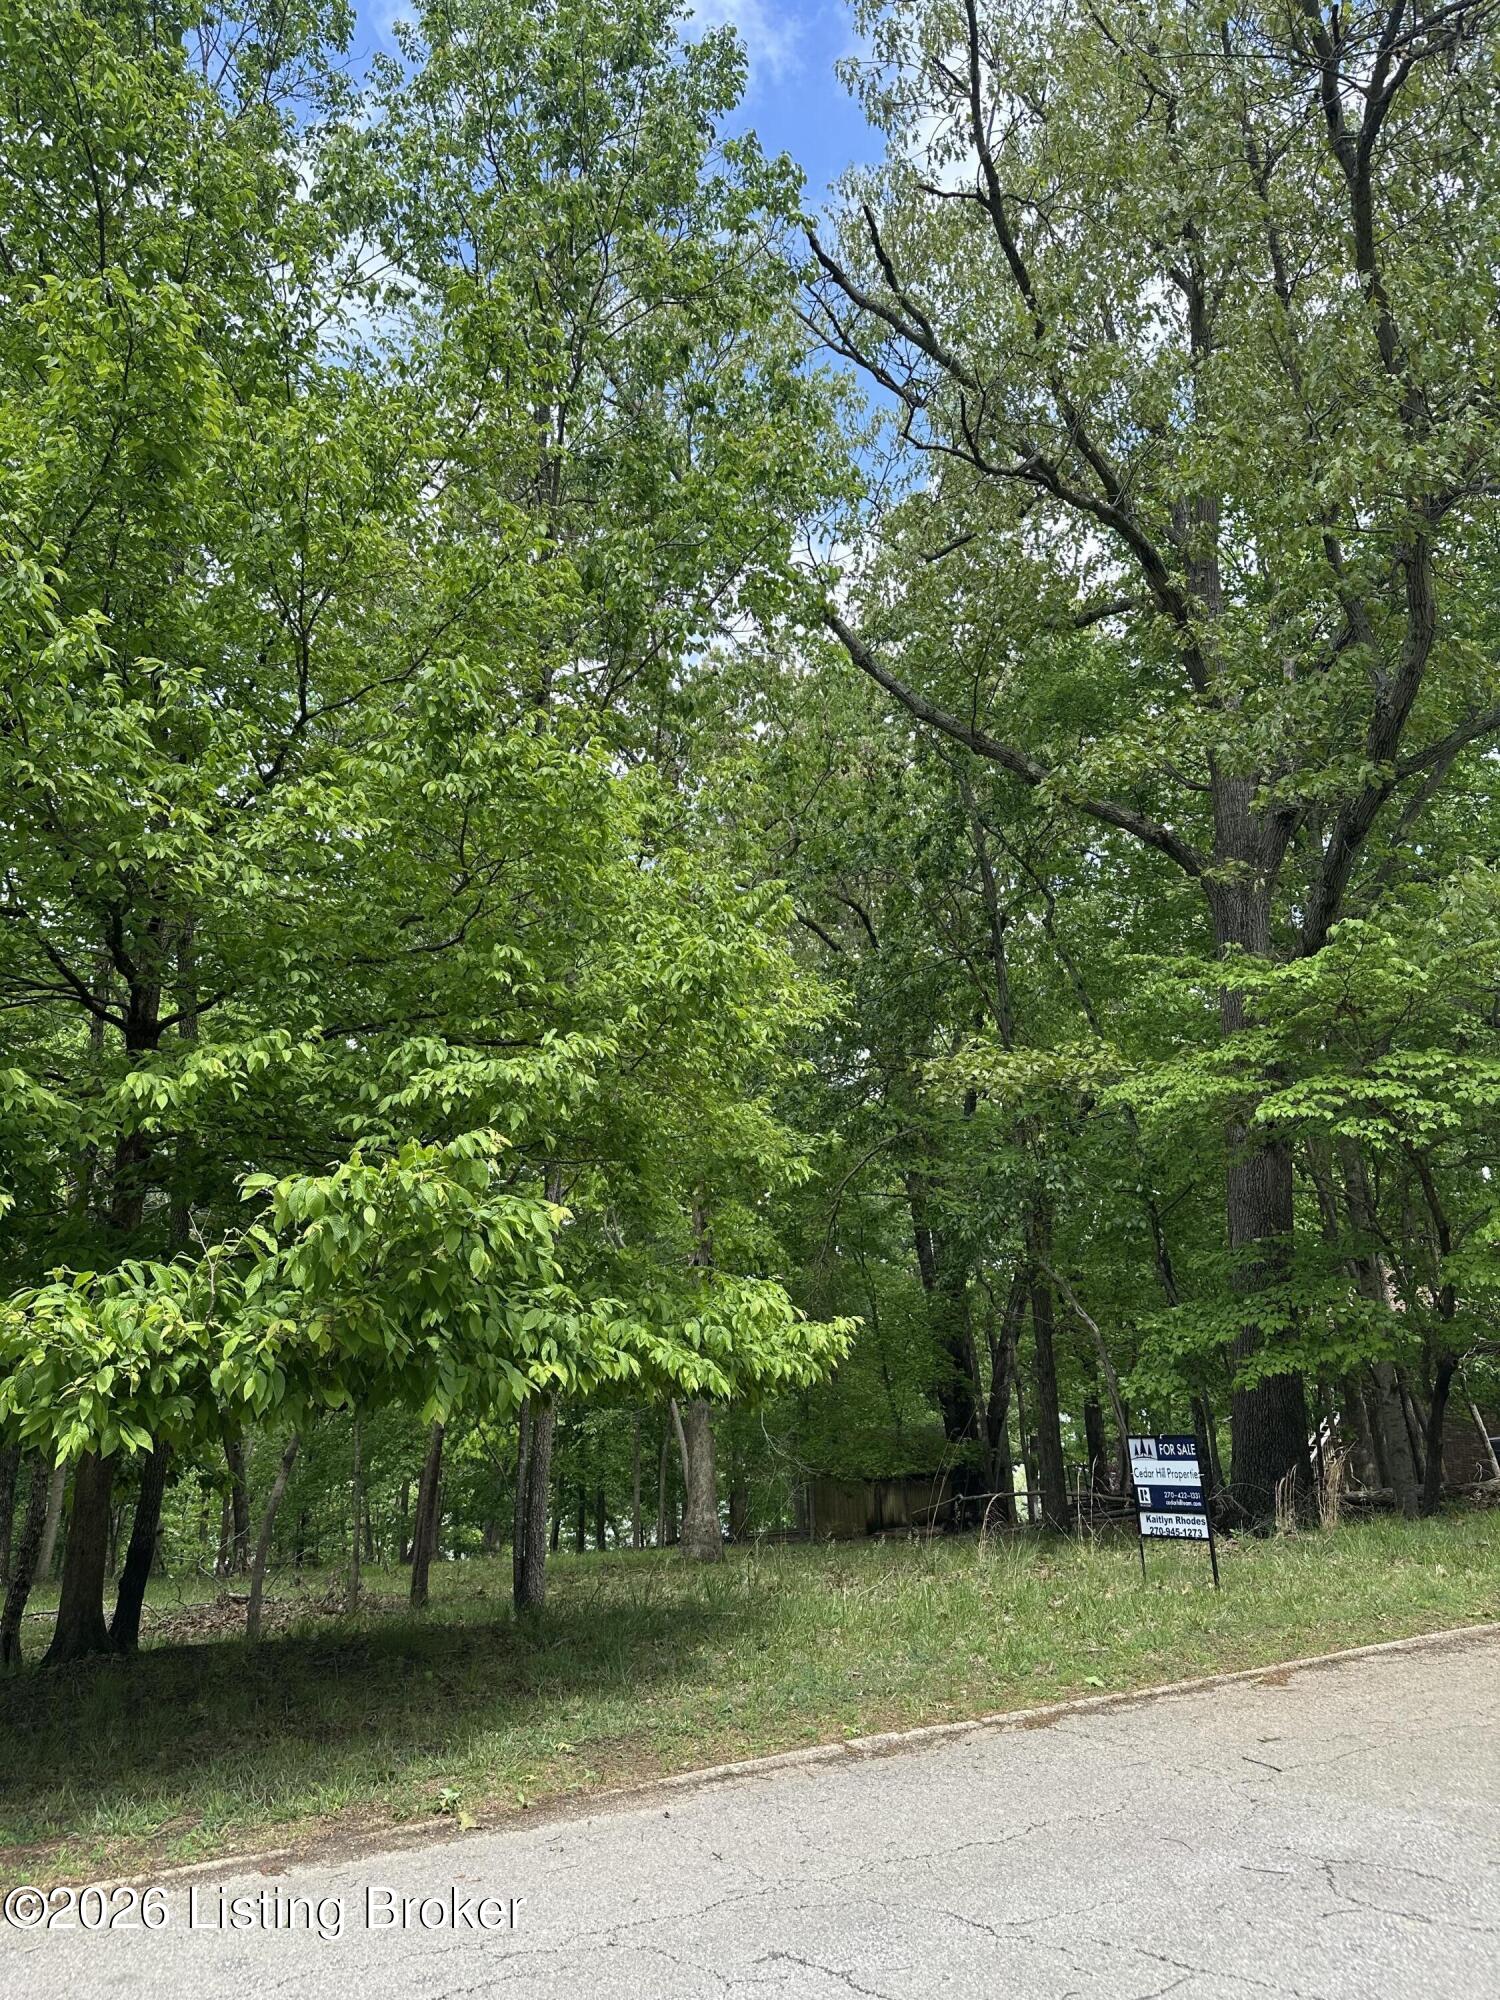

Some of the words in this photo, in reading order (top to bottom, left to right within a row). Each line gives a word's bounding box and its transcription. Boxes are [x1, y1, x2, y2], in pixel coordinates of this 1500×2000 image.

[1159, 1444, 1175, 1456] FOR
[1176, 1444, 1196, 1456] SALE
[1134, 1467, 1154, 1478] Cedar
[1156, 1468, 1166, 1478] Hill
[1146, 1514, 1173, 1526] Kaitlyn
[1175, 1515, 1206, 1526] Rhodes
[1149, 1526, 1203, 1538] 270-945-1273
